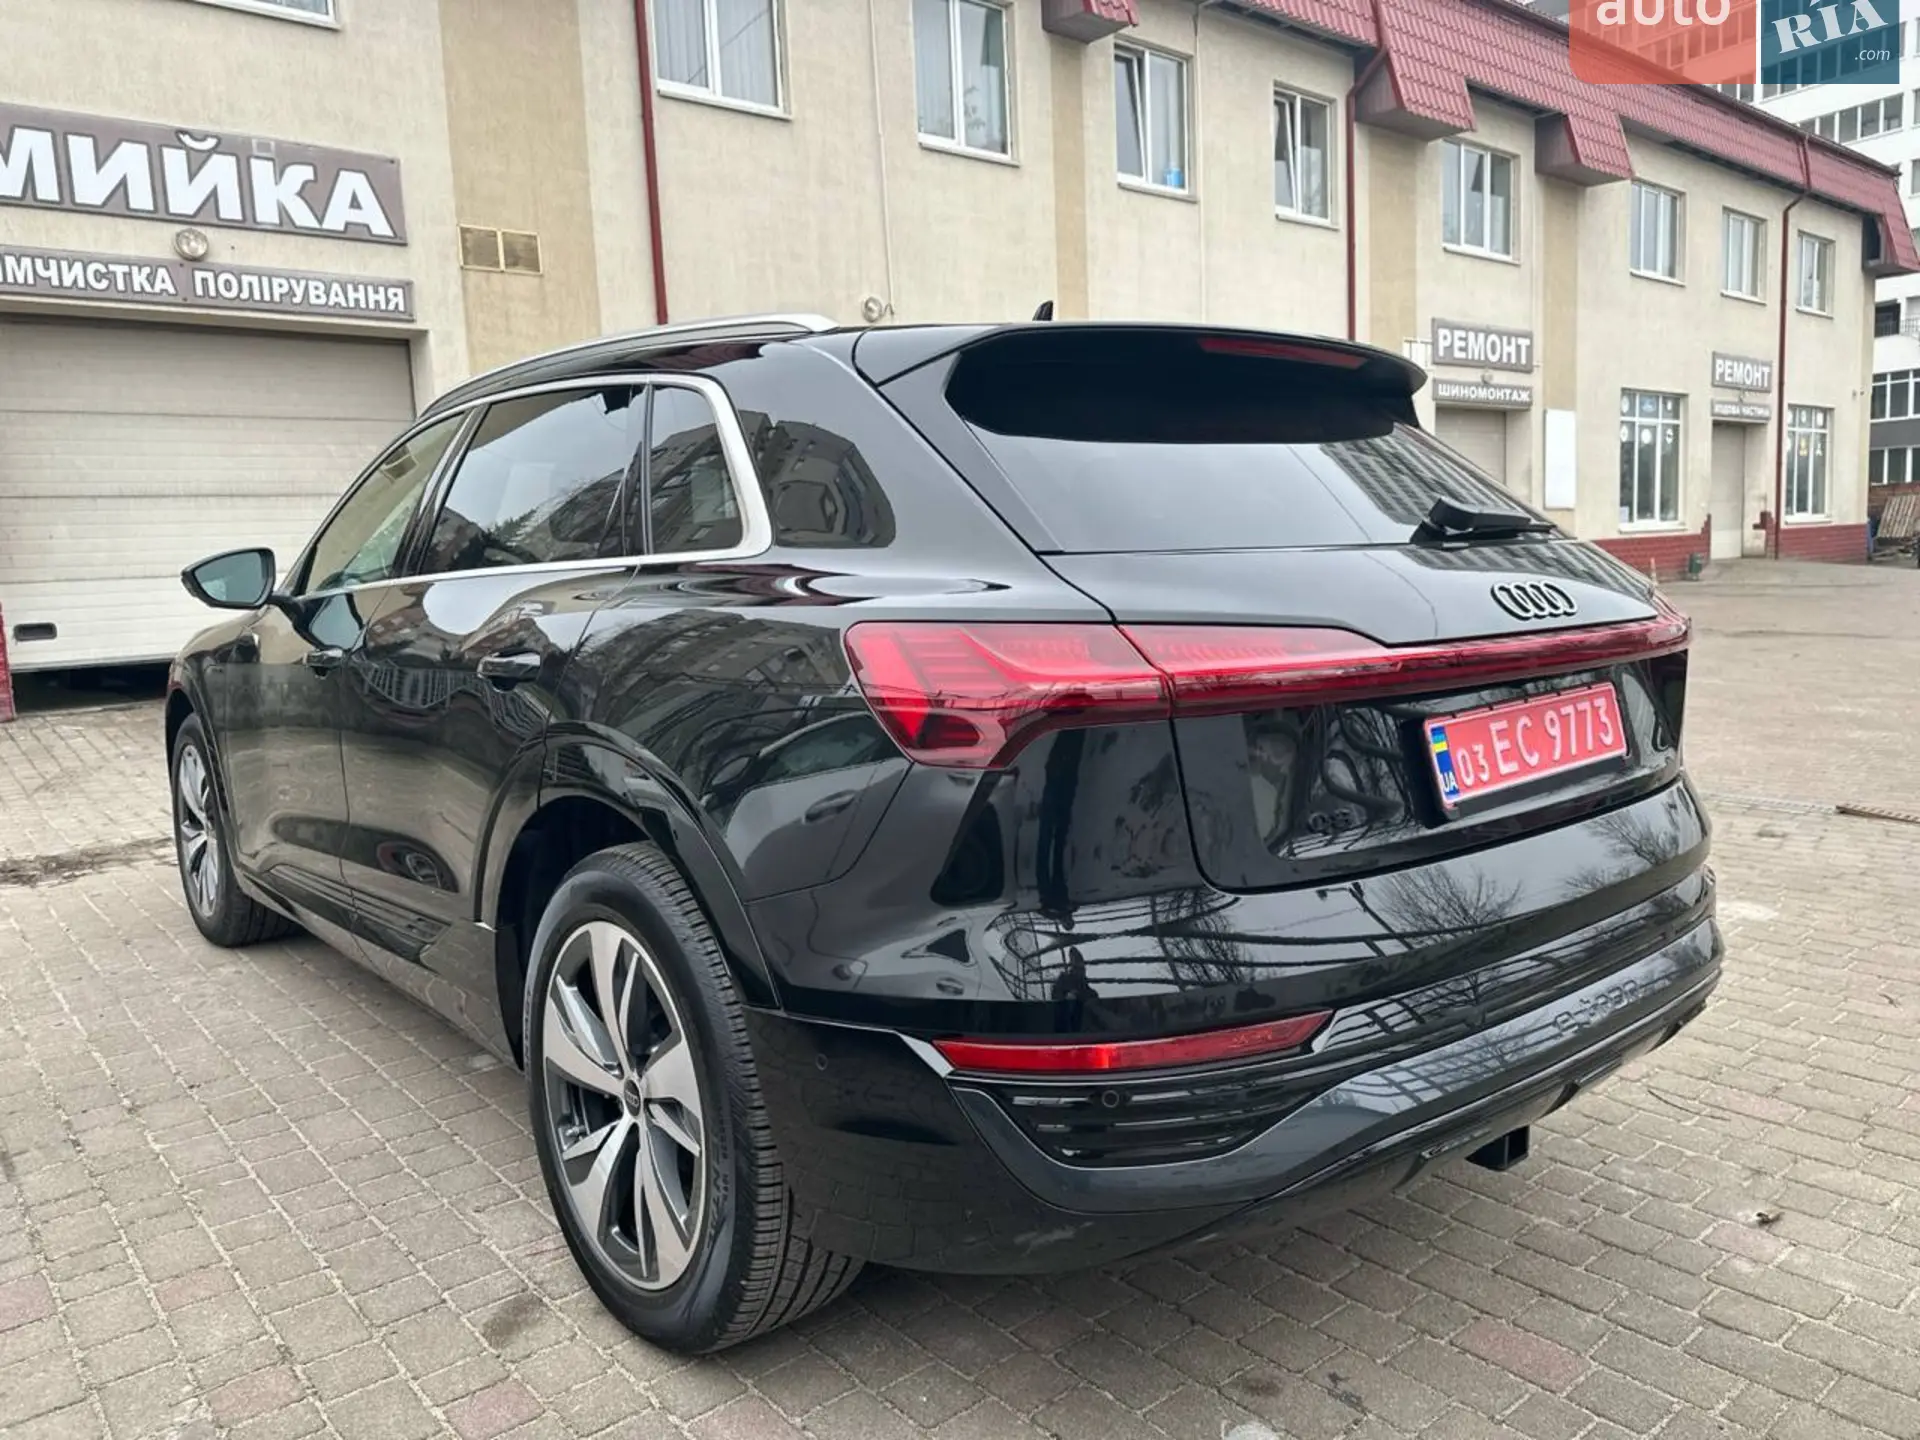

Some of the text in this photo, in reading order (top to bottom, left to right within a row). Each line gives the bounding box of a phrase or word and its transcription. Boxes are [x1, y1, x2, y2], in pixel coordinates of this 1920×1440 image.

[0, 254, 406, 312] МЧИСТКА ПОЛІРУВАННЯ
[1437, 327, 1531, 365] РЕМОНТ
[1715, 358, 1771, 388] РЕМОНТ
[1438, 383, 1531, 402] ШИНОМОНТАЖ
[1455, 744, 1490, 787] 03
[1544, 697, 1614, 761] 9773
[1440, 771, 1459, 793] UA
